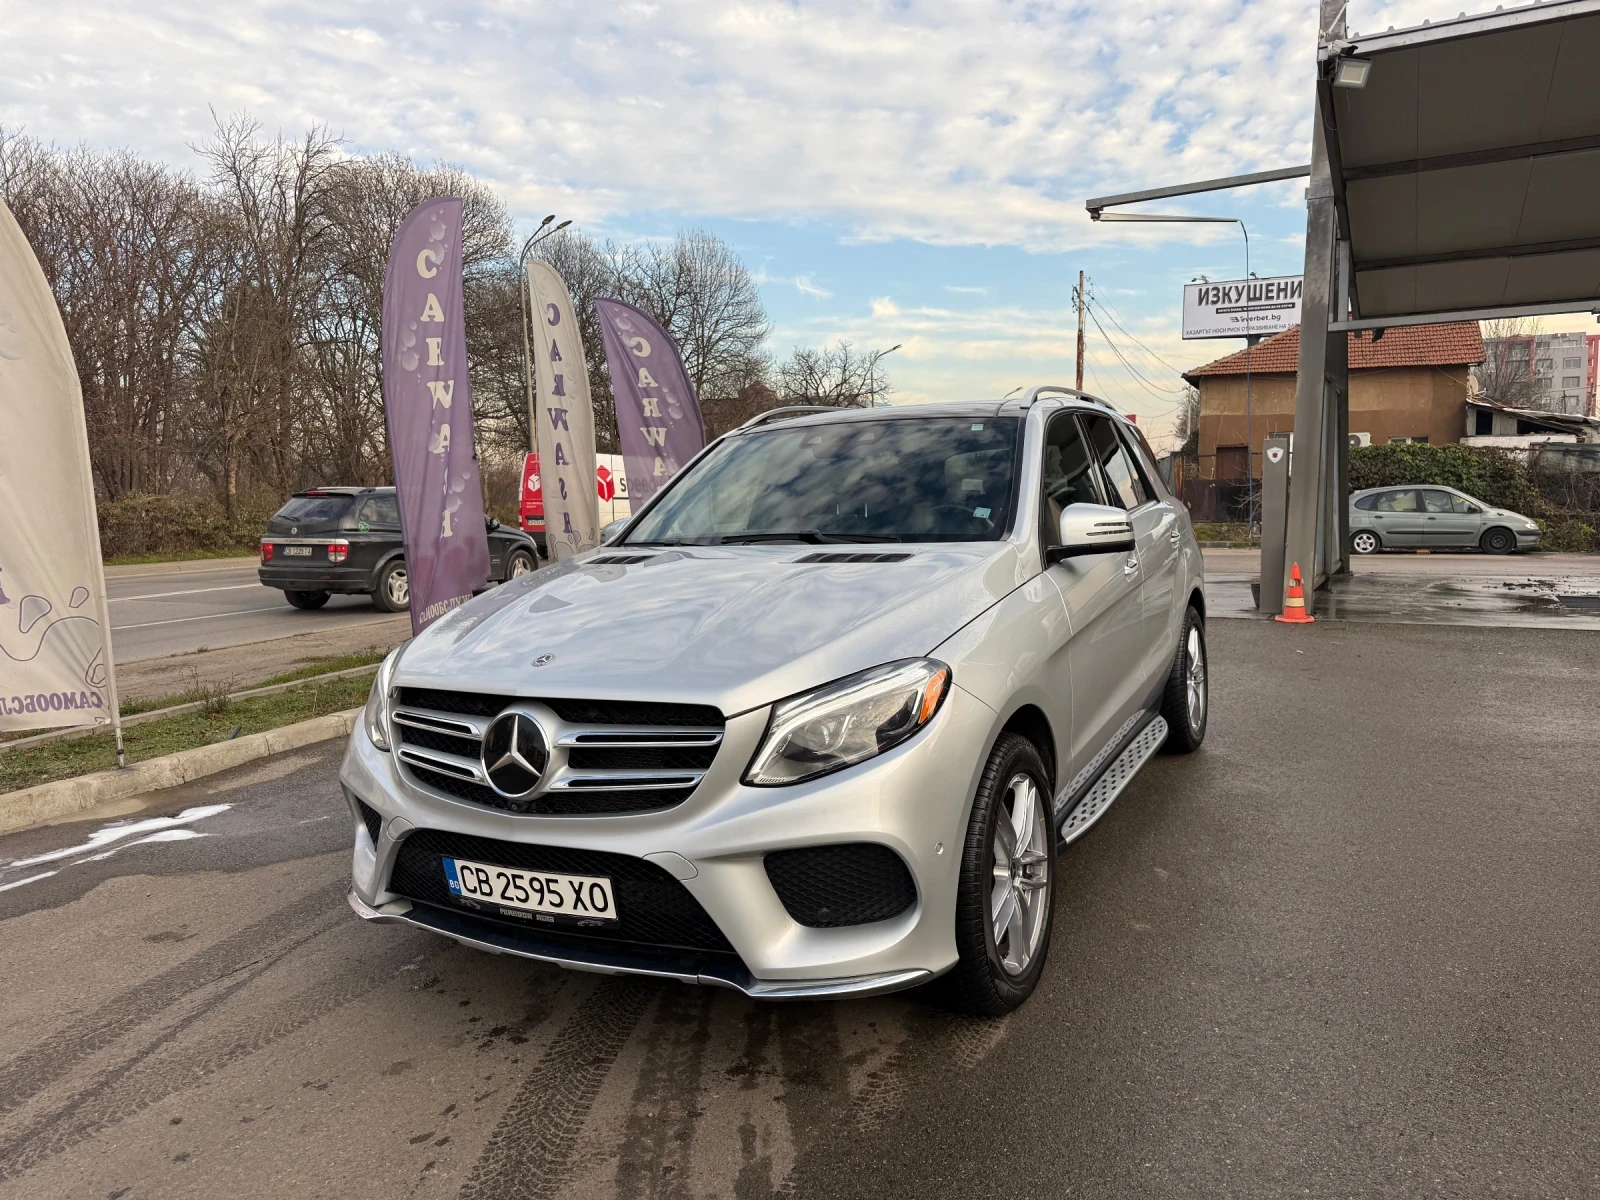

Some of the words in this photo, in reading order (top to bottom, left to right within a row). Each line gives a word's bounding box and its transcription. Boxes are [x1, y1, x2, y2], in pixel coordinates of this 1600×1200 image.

[1198, 280, 1302, 307] ИЗКУШЕНИ
[449, 879, 460, 890] BG
[460, 865, 493, 897] CB
[496, 871, 564, 908] 2595
[568, 880, 609, 912] XO
